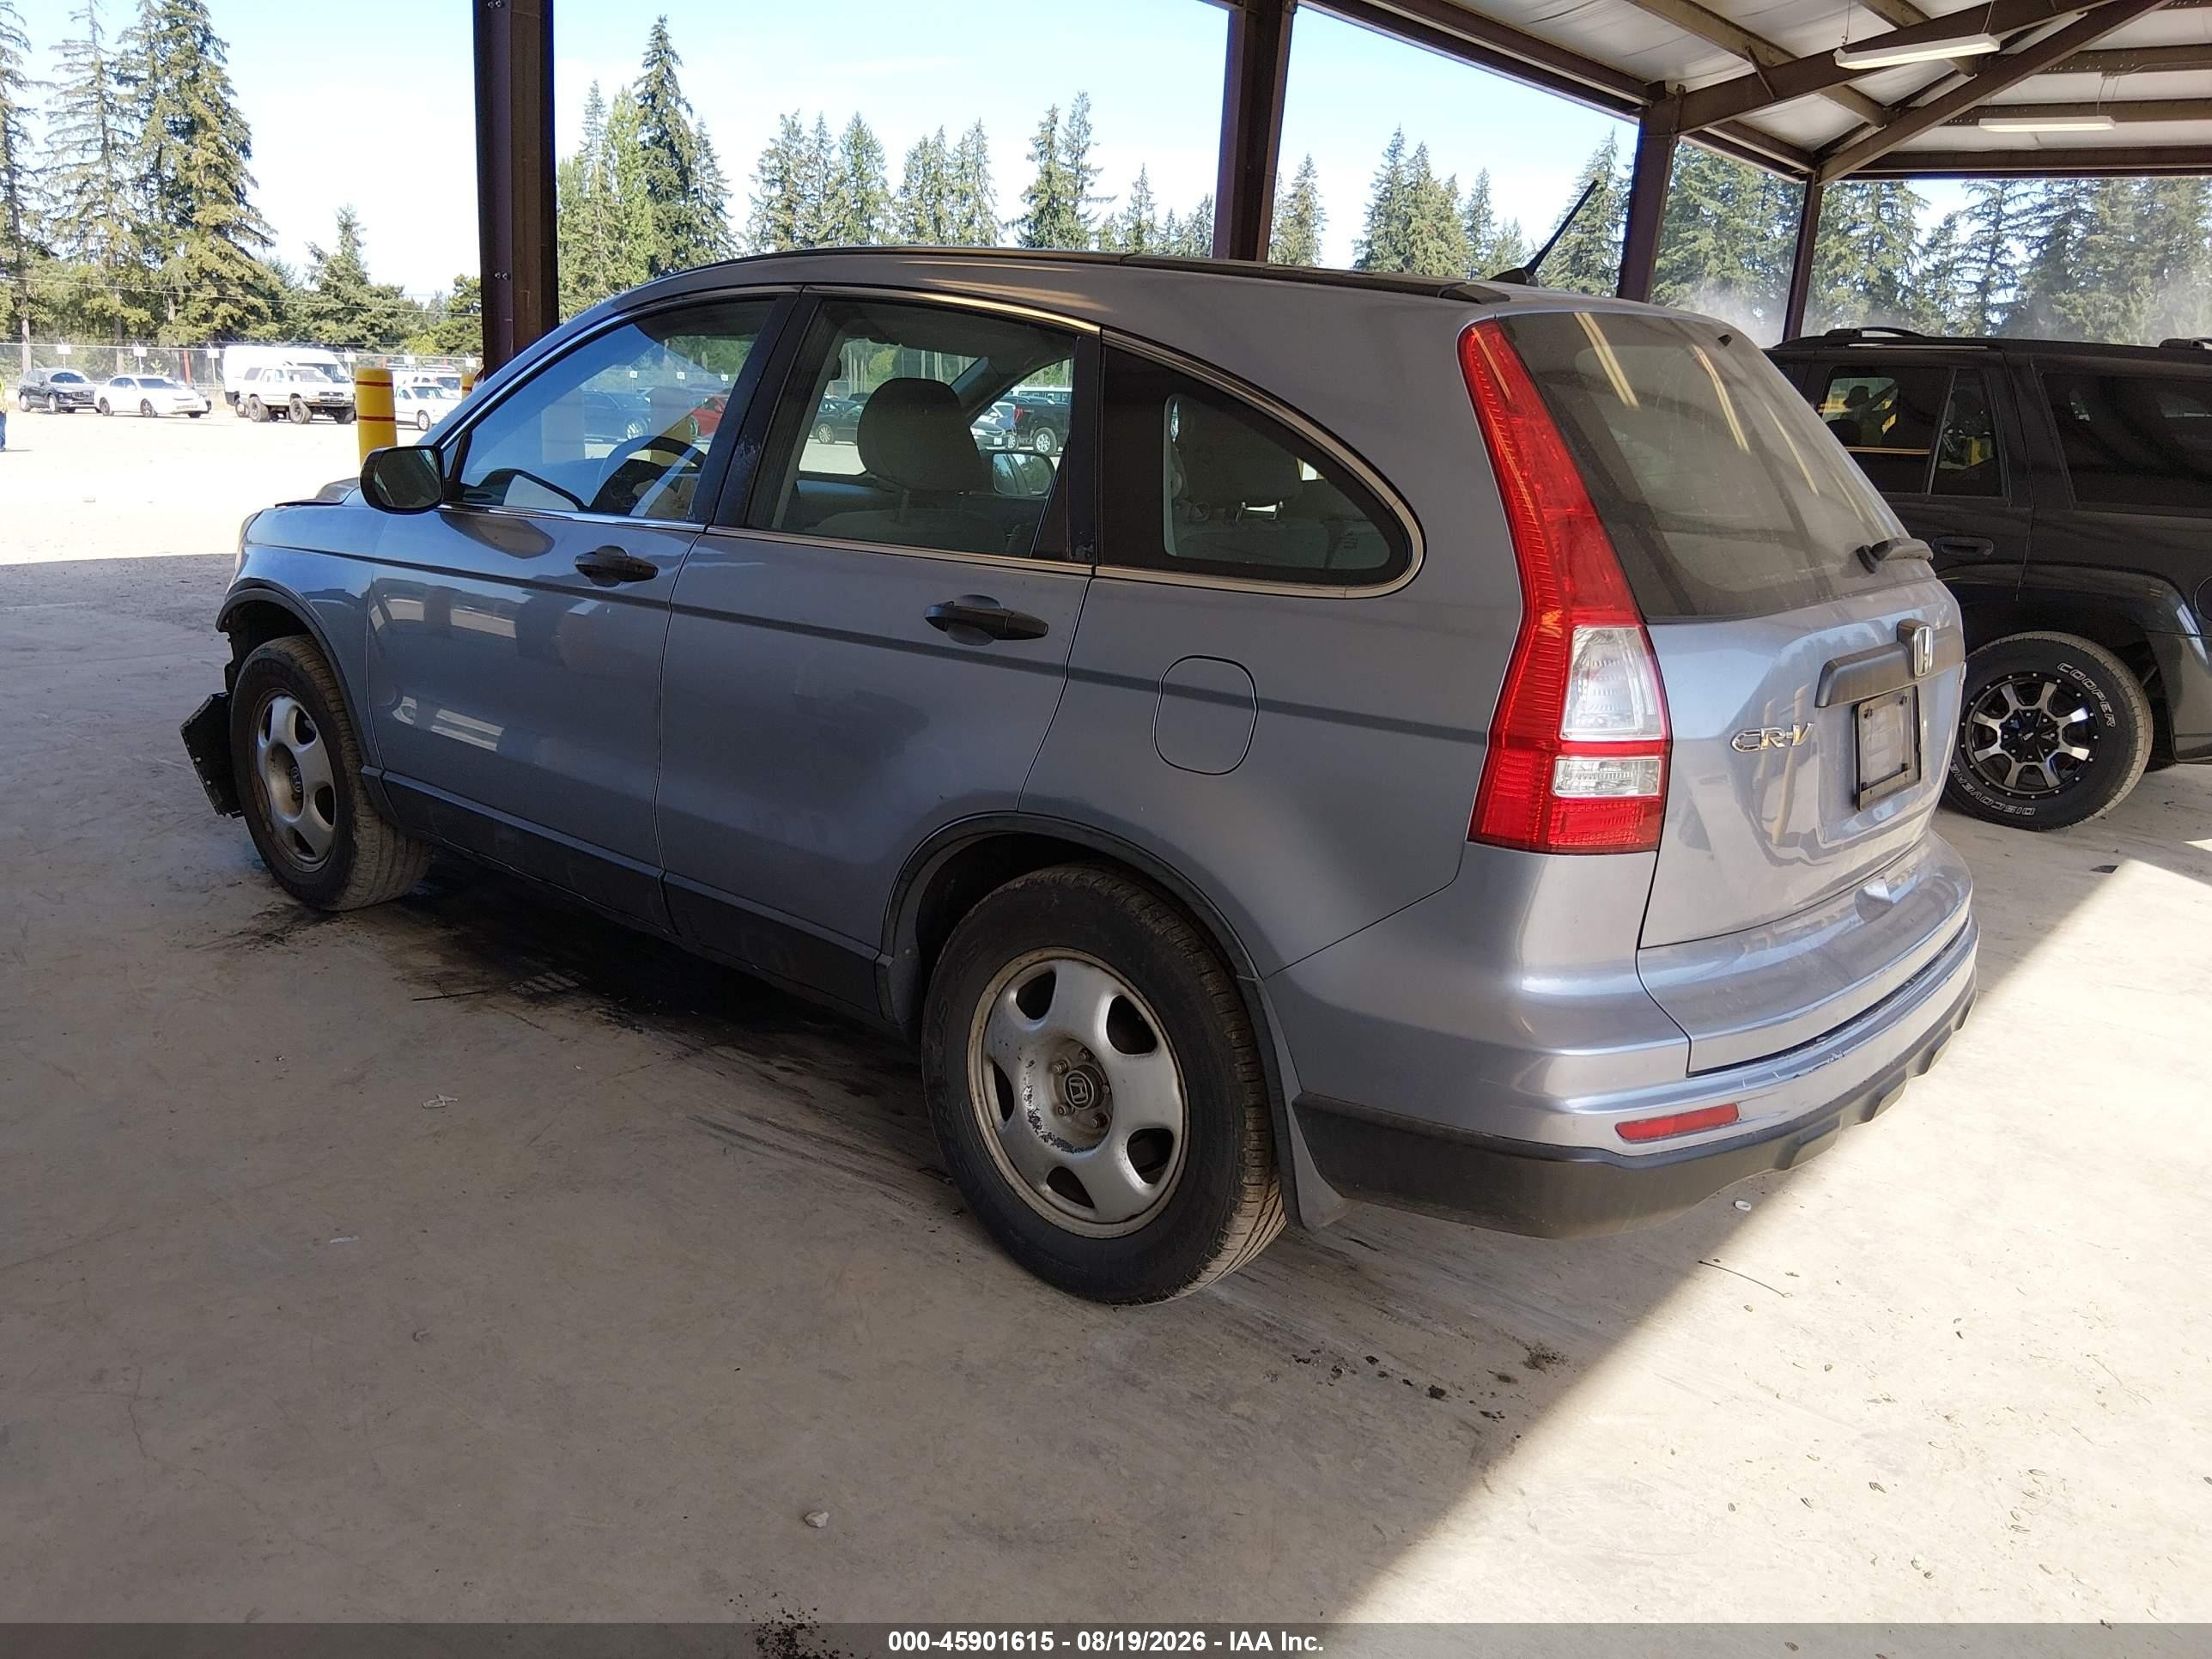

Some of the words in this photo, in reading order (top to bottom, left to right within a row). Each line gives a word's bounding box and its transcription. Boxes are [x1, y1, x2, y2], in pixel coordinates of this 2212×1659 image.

[2057, 662, 2116, 727] COOPER
[1731, 721, 1814, 752] CR-V
[1949, 759, 2036, 816] DISCOVERE
